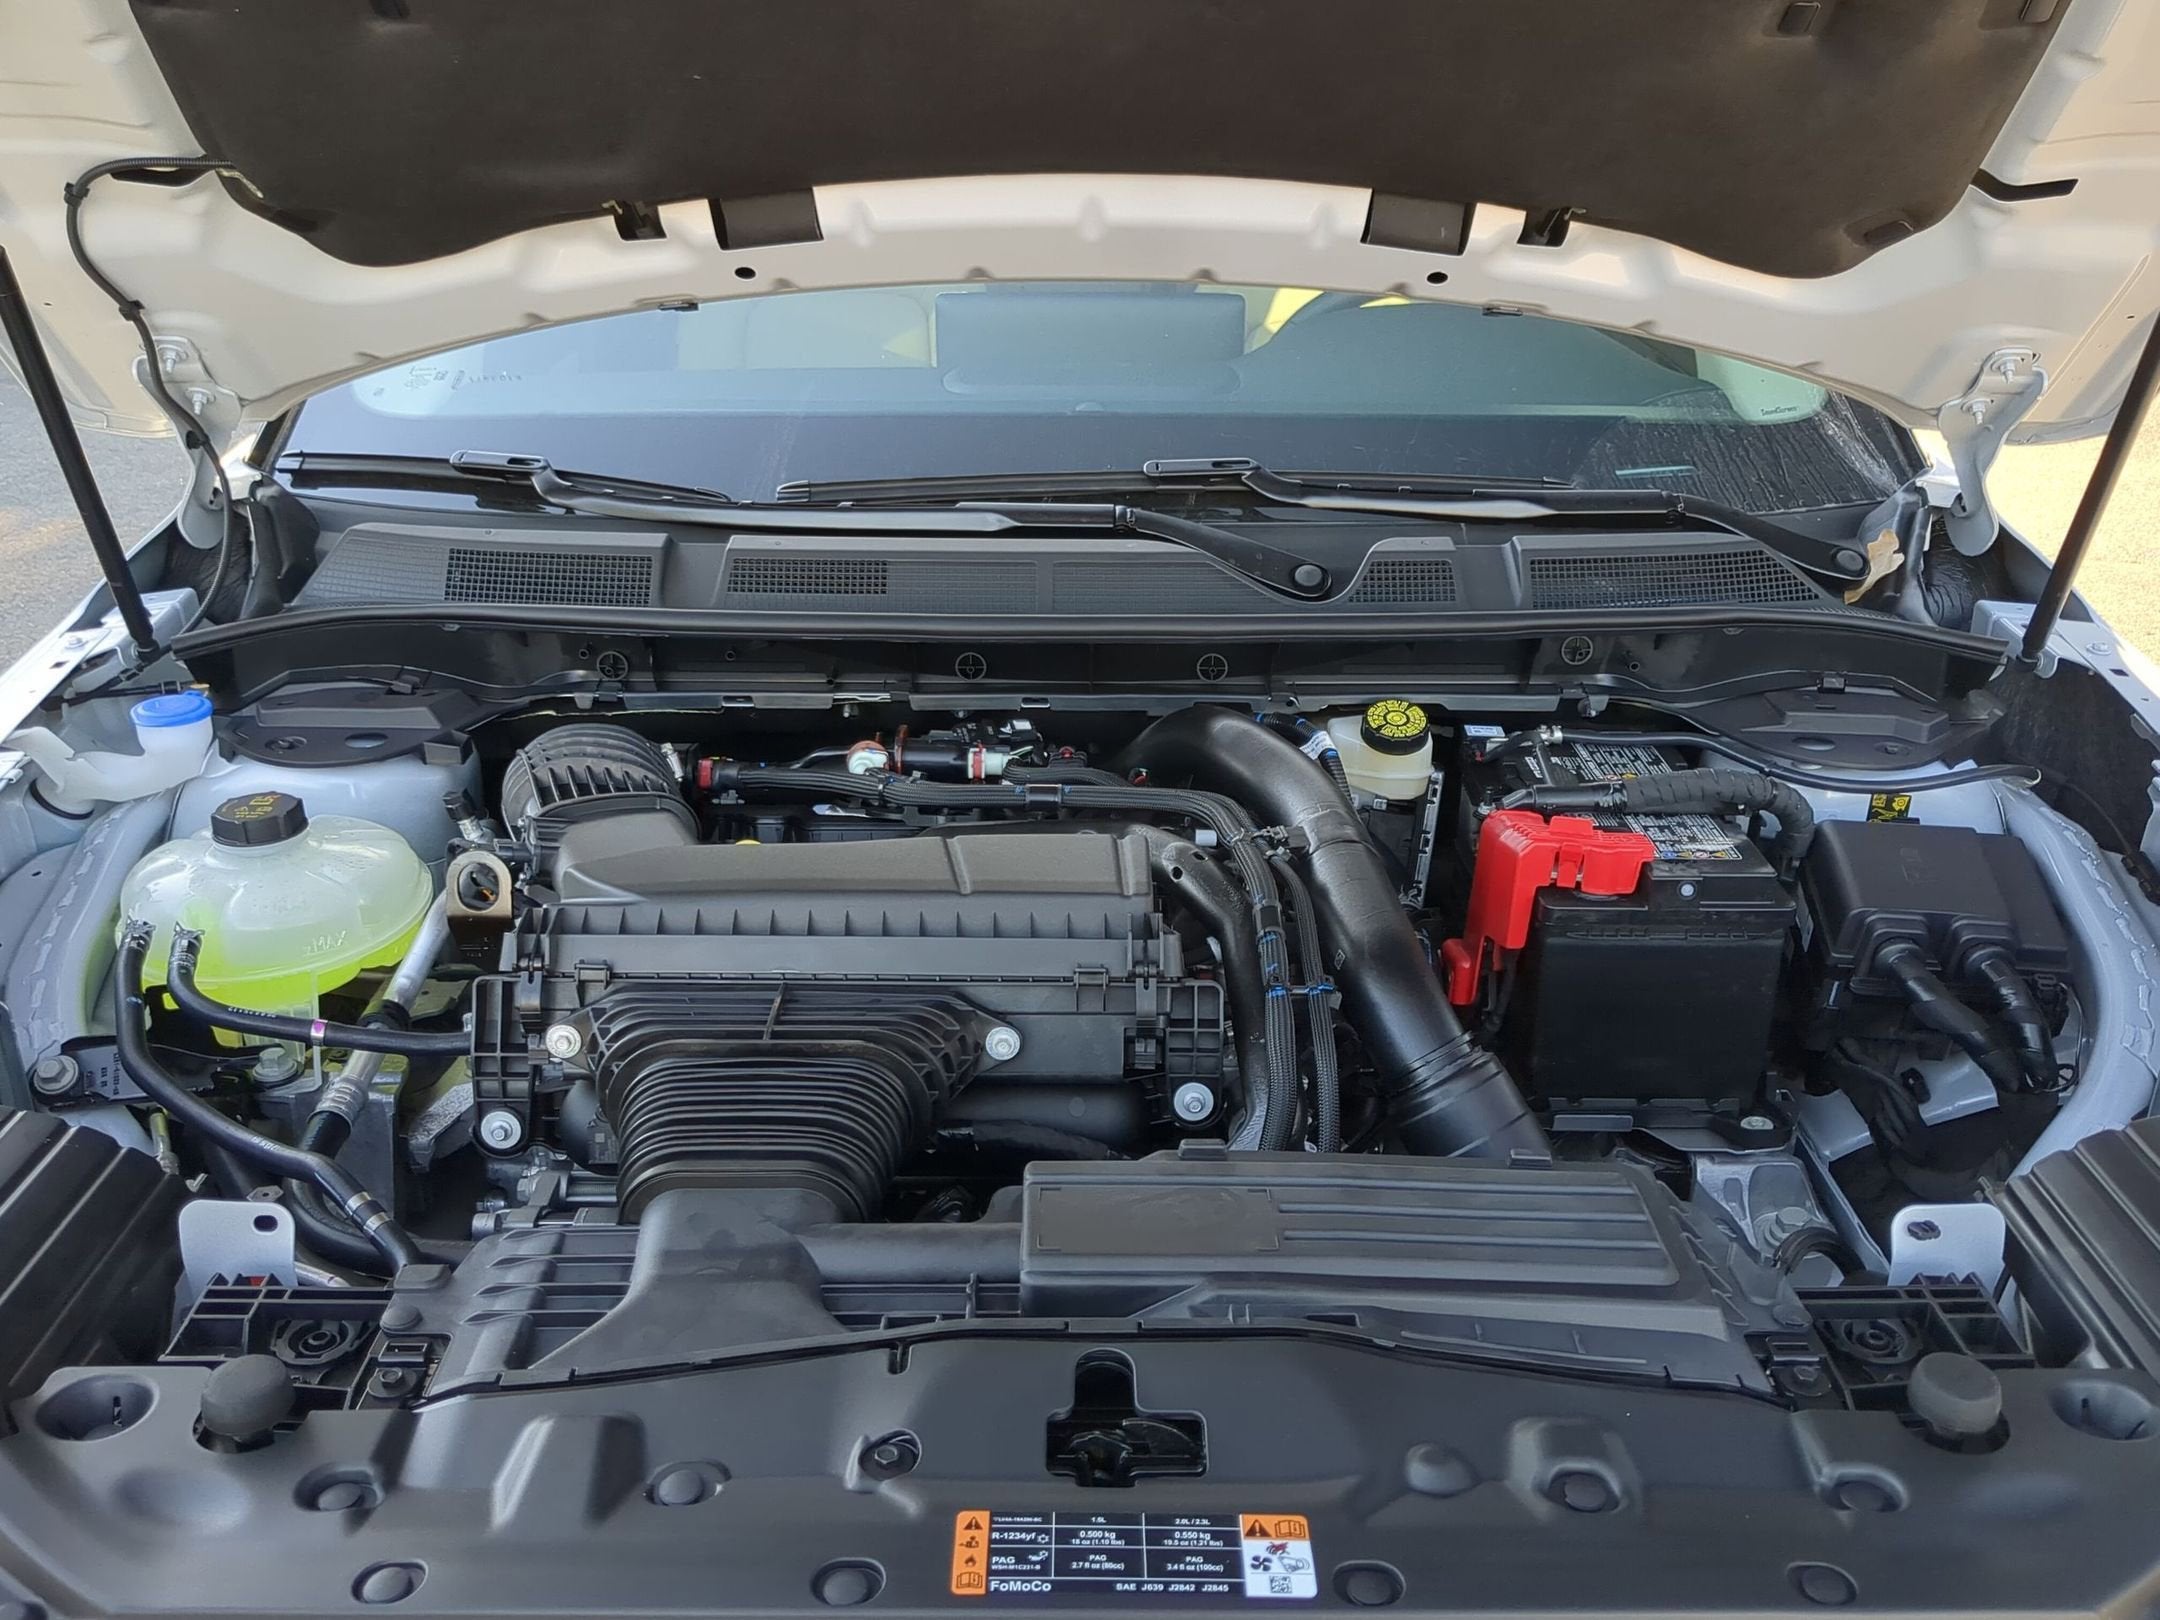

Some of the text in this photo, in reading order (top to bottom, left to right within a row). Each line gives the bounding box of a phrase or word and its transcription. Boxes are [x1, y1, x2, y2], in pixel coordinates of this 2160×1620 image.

[992, 1532, 1036, 1541] R-1234yf
[1080, 1530, 1116, 1539] 0.500 kg
[1174, 1531, 1211, 1541] 0.550 kg
[992, 1556, 1016, 1564] PAG
[990, 1580, 1052, 1592] FoMoCo
[1116, 1583, 1137, 1591] SAE
[1141, 1583, 1164, 1591] J639
